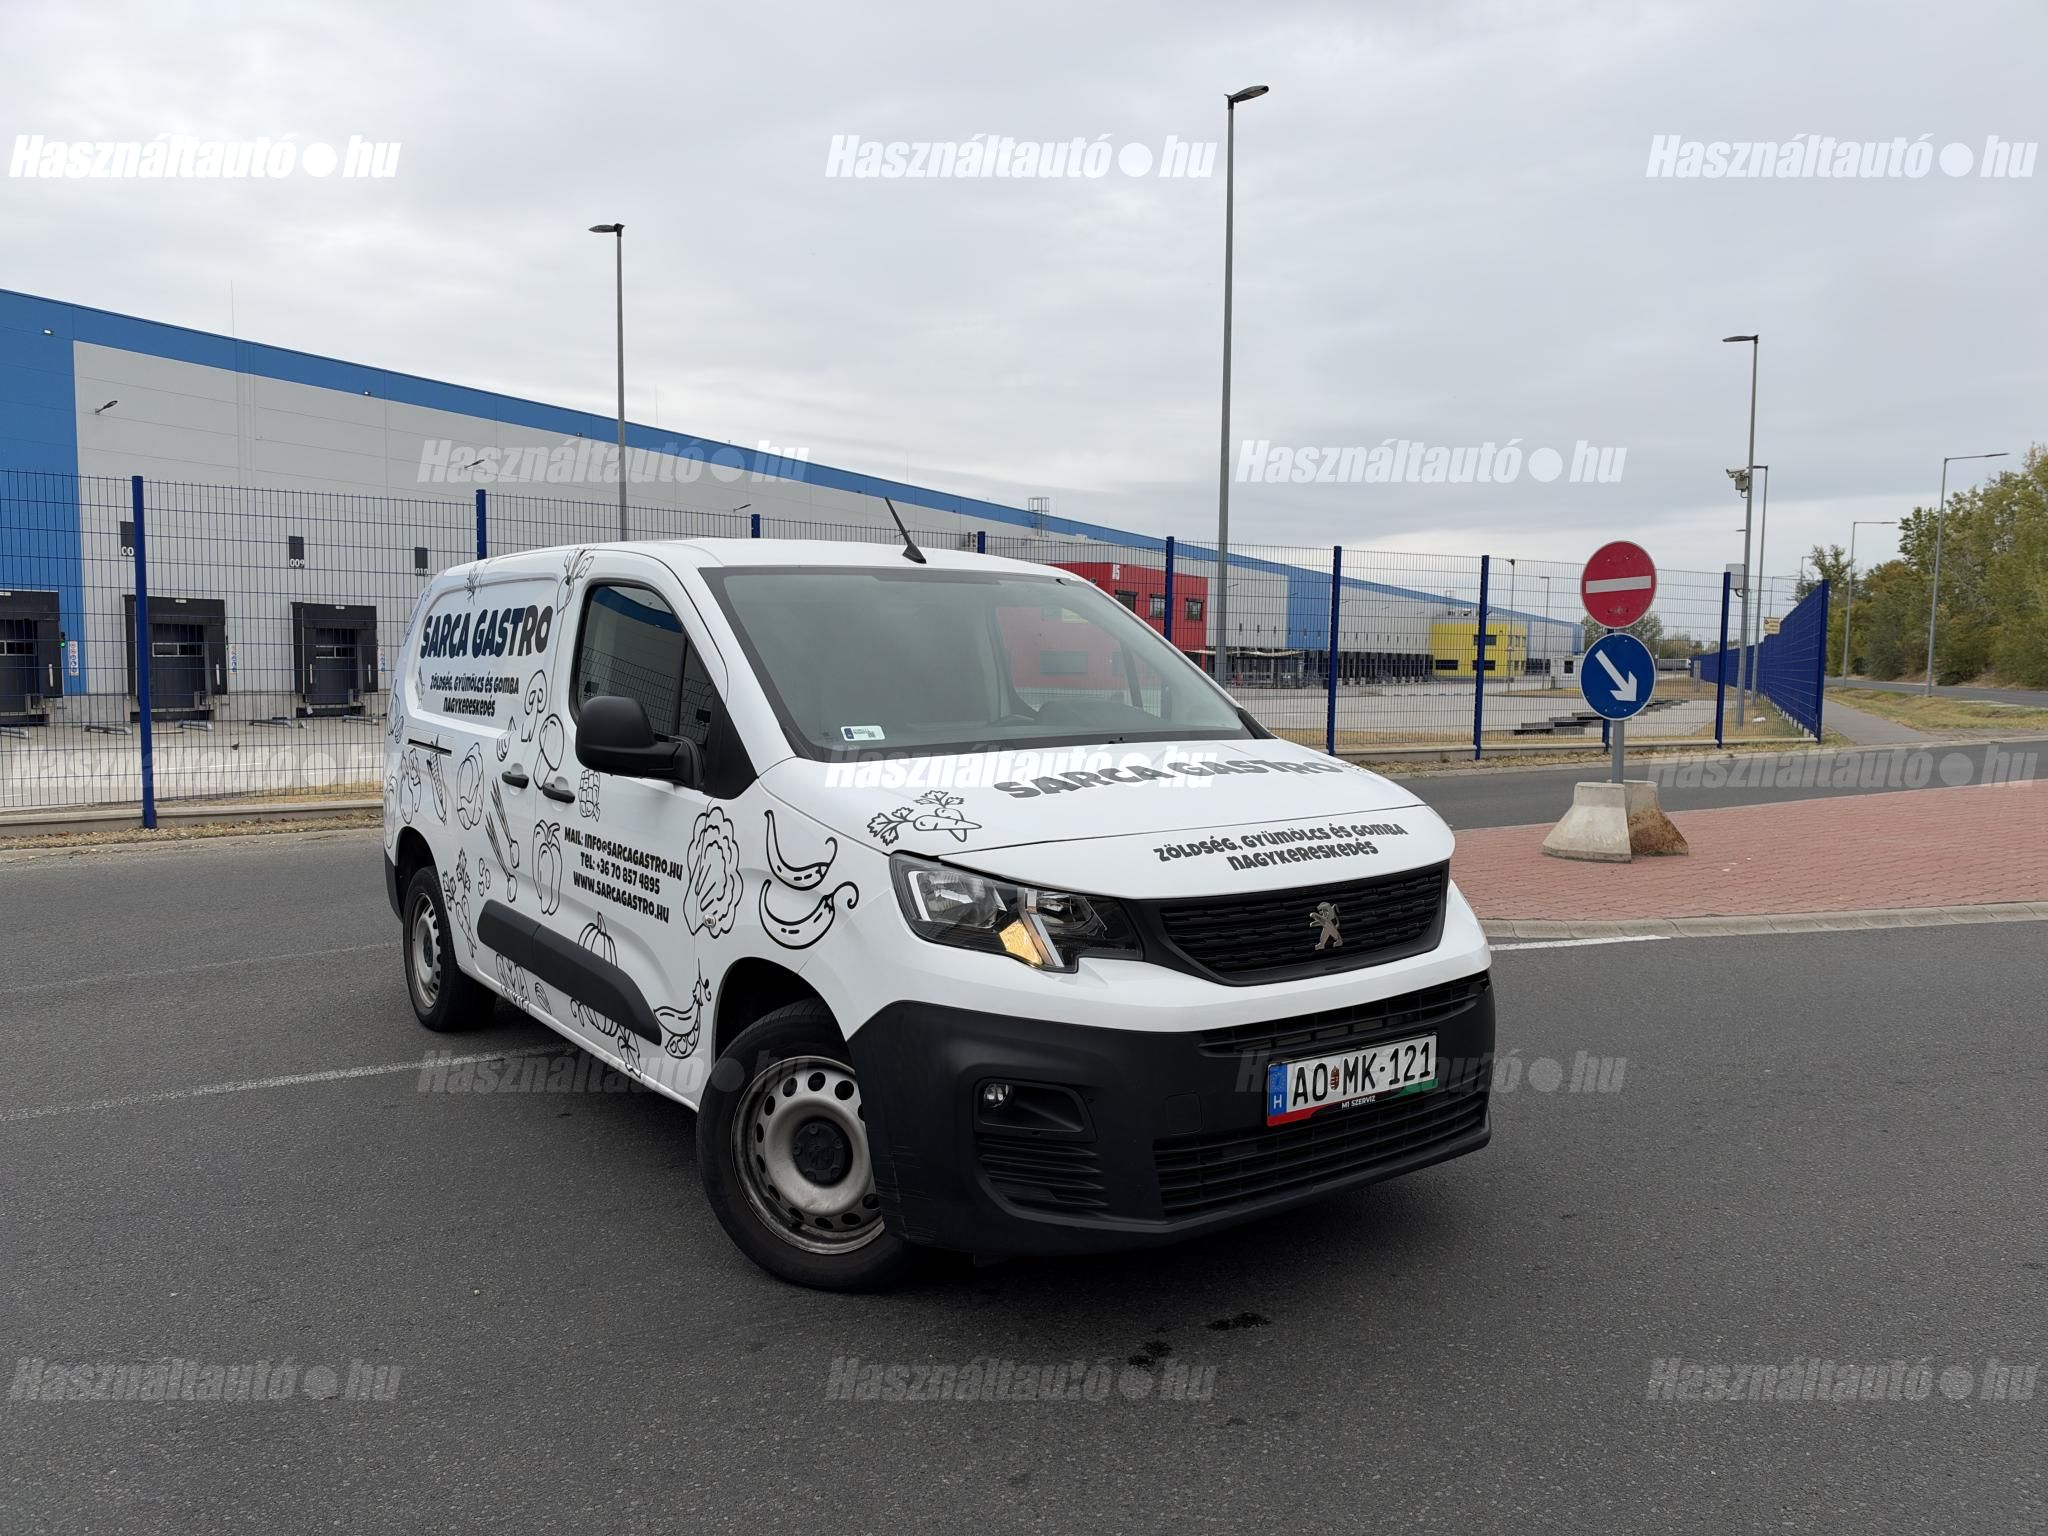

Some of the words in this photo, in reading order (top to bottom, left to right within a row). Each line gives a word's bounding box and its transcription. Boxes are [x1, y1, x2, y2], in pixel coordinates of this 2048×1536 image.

[420, 612, 471, 659] SARCA
[472, 605, 553, 658] GASTRO
[994, 764, 1176, 798] SARCA
[1163, 759, 1343, 776] GASTRO
[564, 826, 584, 846] MAIL:
[596, 858, 610, 877] +36
[611, 863, 621, 881] 70
[622, 867, 638, 887] 857
[638, 873, 660, 895] 4895
[573, 870, 669, 924] WWW.SARCAGASTRO.HU
[1273, 1093, 1283, 1110] H
[1292, 1063, 1328, 1107] AO
[1350, 1095, 1376, 1107] SZERVIZ
